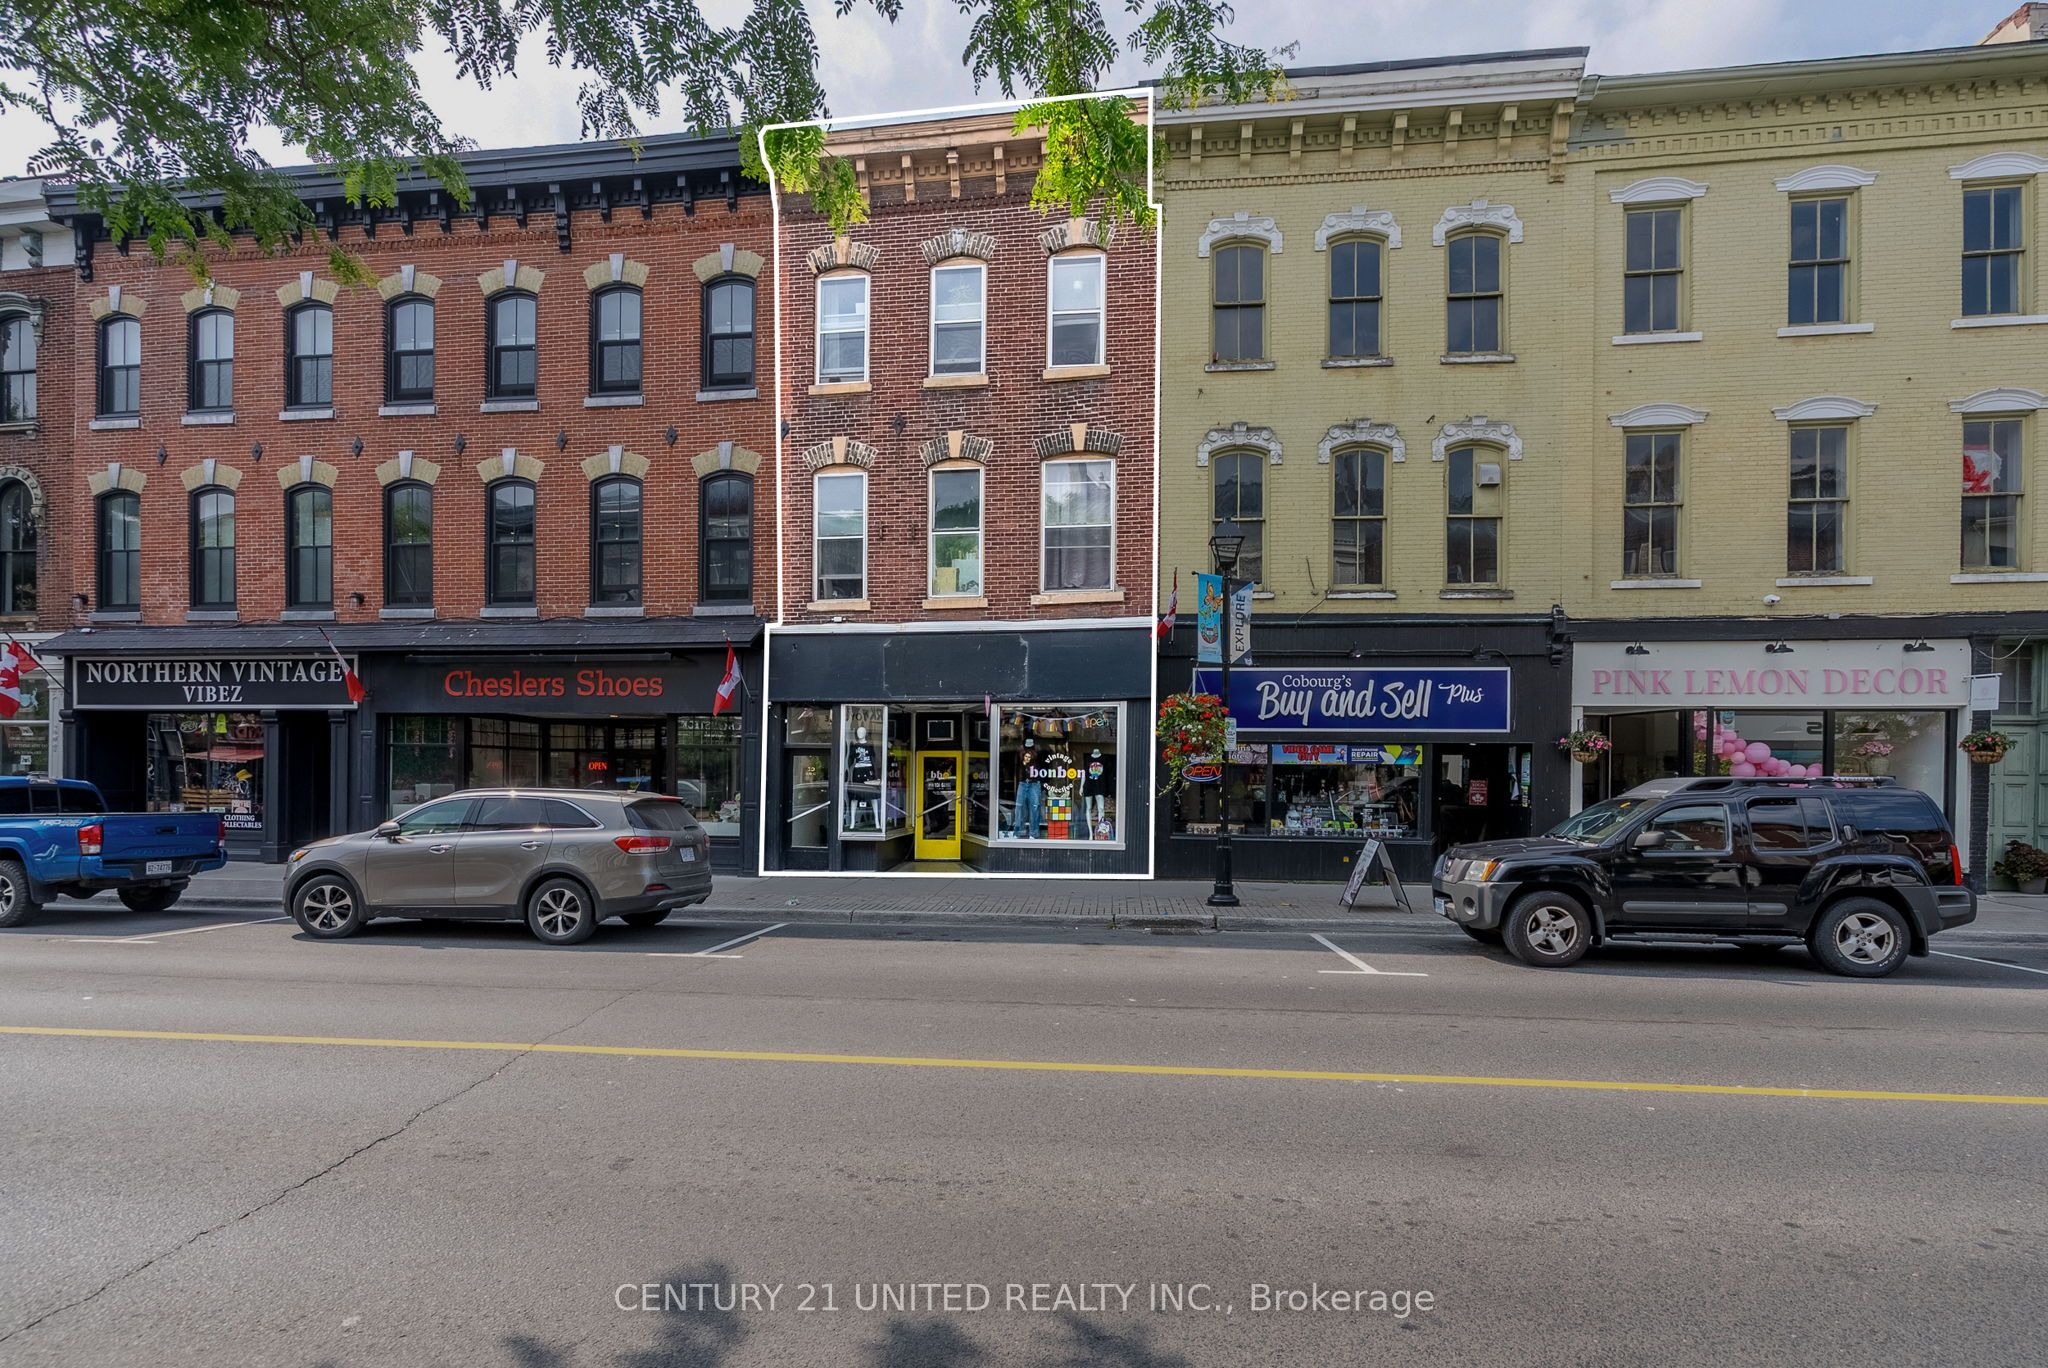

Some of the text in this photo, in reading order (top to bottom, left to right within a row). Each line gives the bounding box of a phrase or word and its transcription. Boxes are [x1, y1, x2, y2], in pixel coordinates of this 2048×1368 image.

[1235, 593, 1246, 652] EXPLORE
[86, 661, 343, 683] NORTHERN VINTAGE
[444, 669, 664, 697] Cheslers Shoes
[1282, 674, 1352, 690] Cobourg's
[1591, 668, 1949, 695] PINK LEMON DECOR
[182, 685, 243, 703] VIBEZ
[1256, 679, 1484, 726] Buy and Sell Plus
[588, 761, 607, 770] OPEN
[1045, 753, 1073, 764] vintage
[1029, 765, 1086, 780] bonbon
[1184, 766, 1222, 777] OPEN
[1043, 782, 1074, 793] collective
[224, 814, 255, 822] CLOTHING
